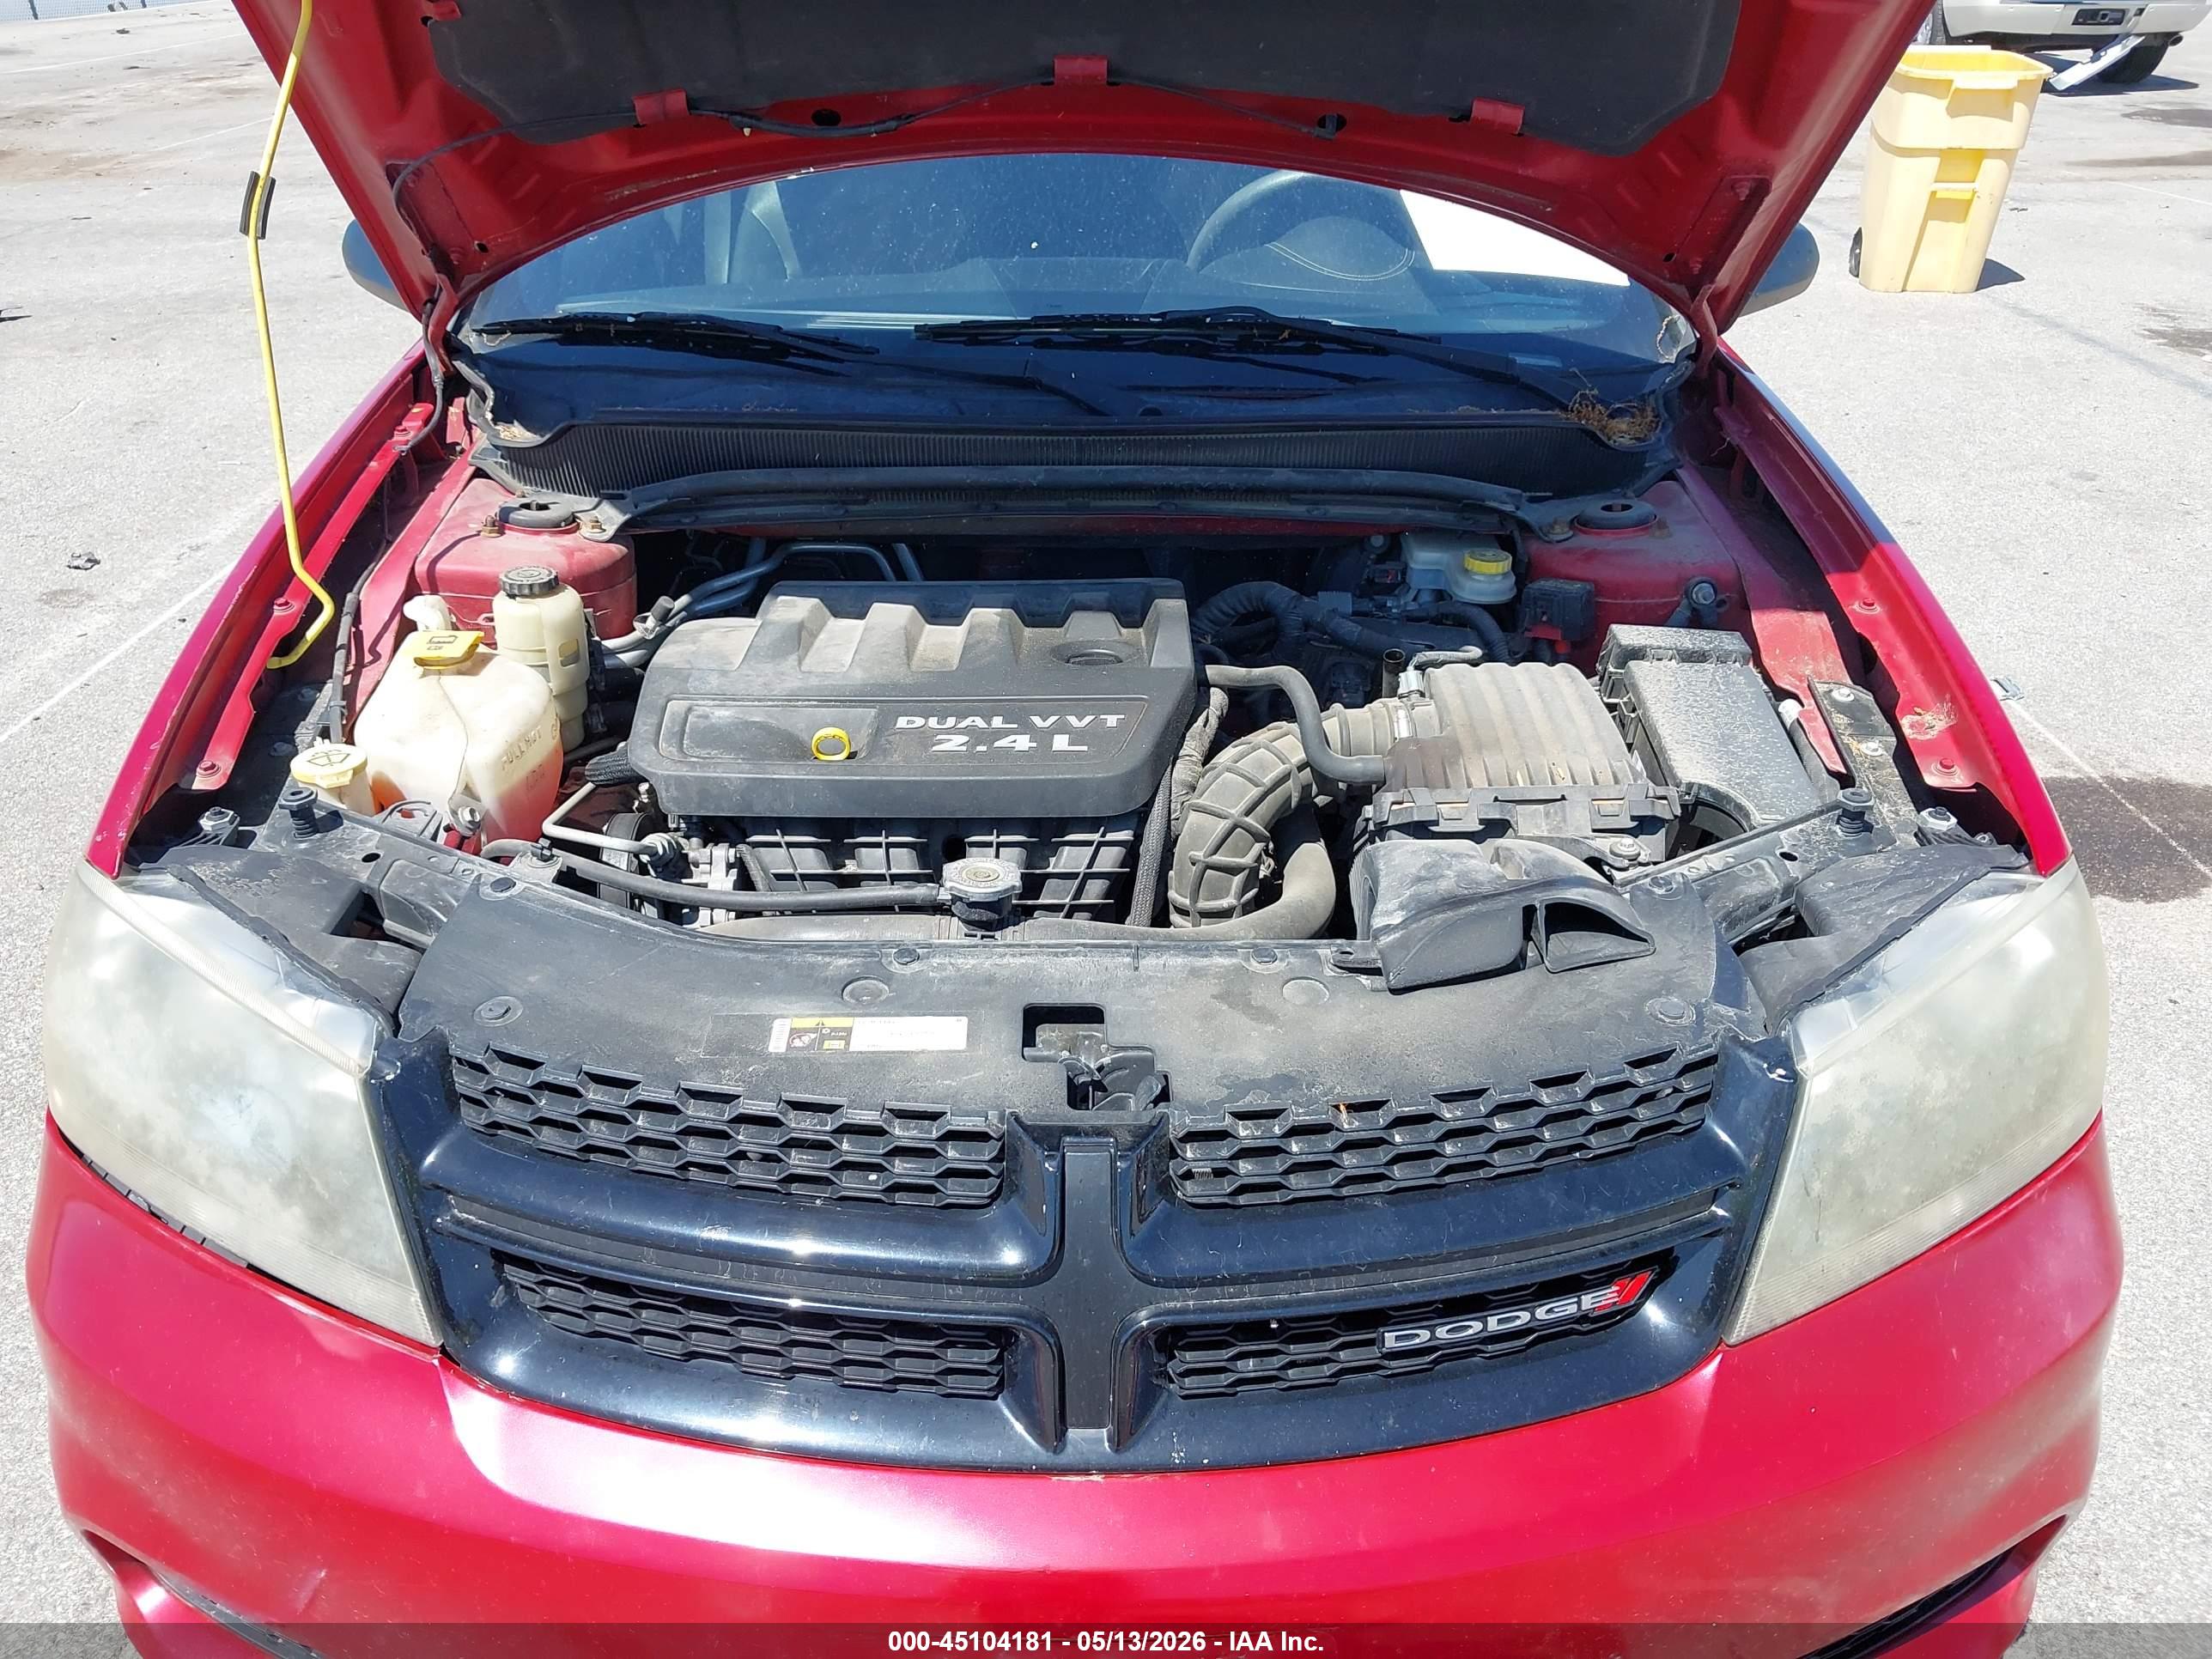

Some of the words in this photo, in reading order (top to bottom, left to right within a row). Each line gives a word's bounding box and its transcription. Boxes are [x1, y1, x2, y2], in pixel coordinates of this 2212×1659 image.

[895, 716, 1018, 729] DUAL
[1029, 714, 1125, 728] VVT
[931, 734, 1037, 752] 2.4
[1051, 734, 1089, 752] L
[1383, 1285, 1621, 1348] DODGE
